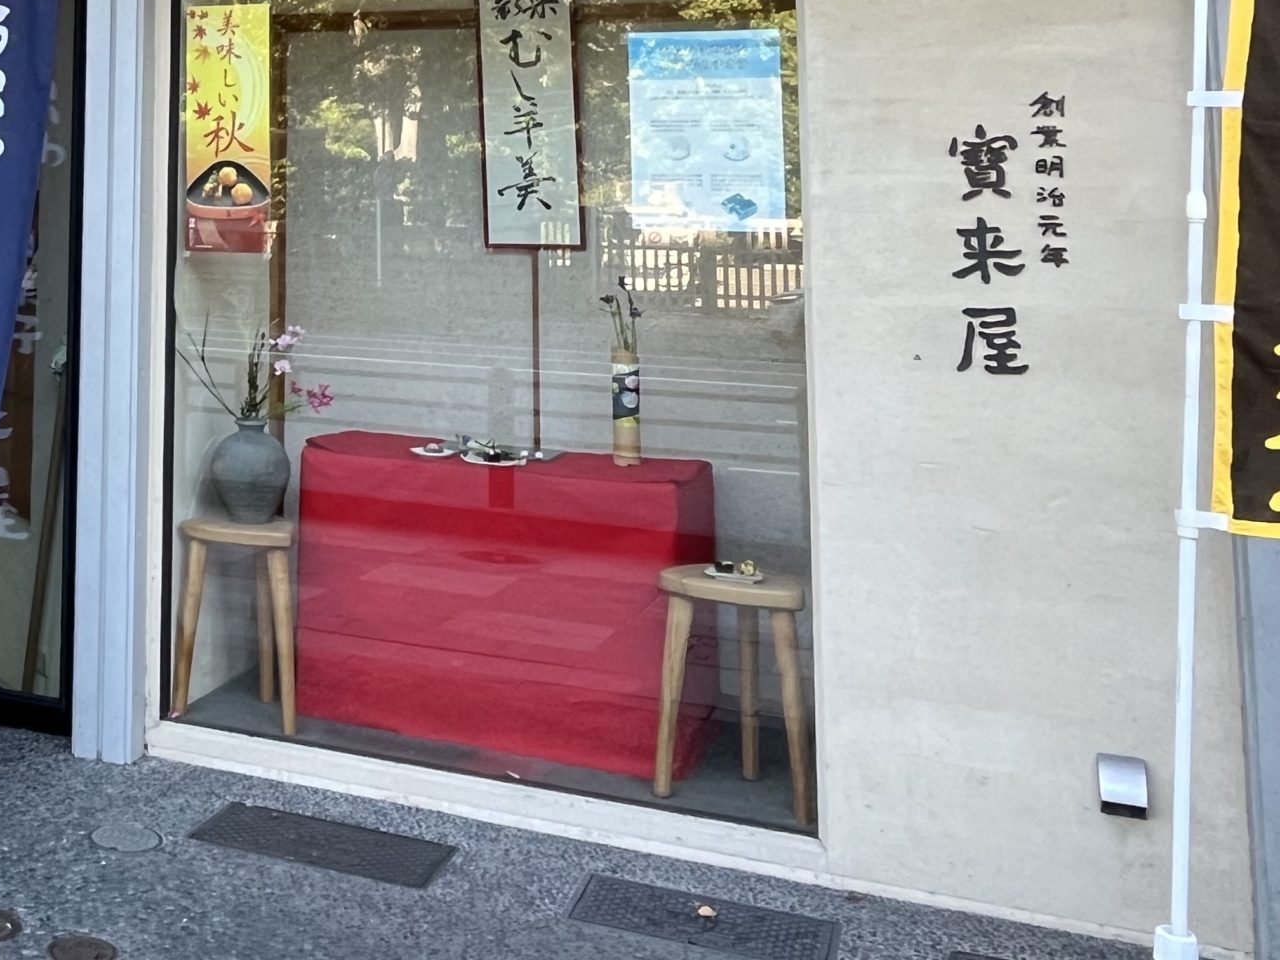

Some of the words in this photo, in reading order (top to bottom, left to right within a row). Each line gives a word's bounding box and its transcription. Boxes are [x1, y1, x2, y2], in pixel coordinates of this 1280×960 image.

[203, 8, 255, 158] 美味しい秋
[1028, 91, 1070, 268] 創業明治元年
